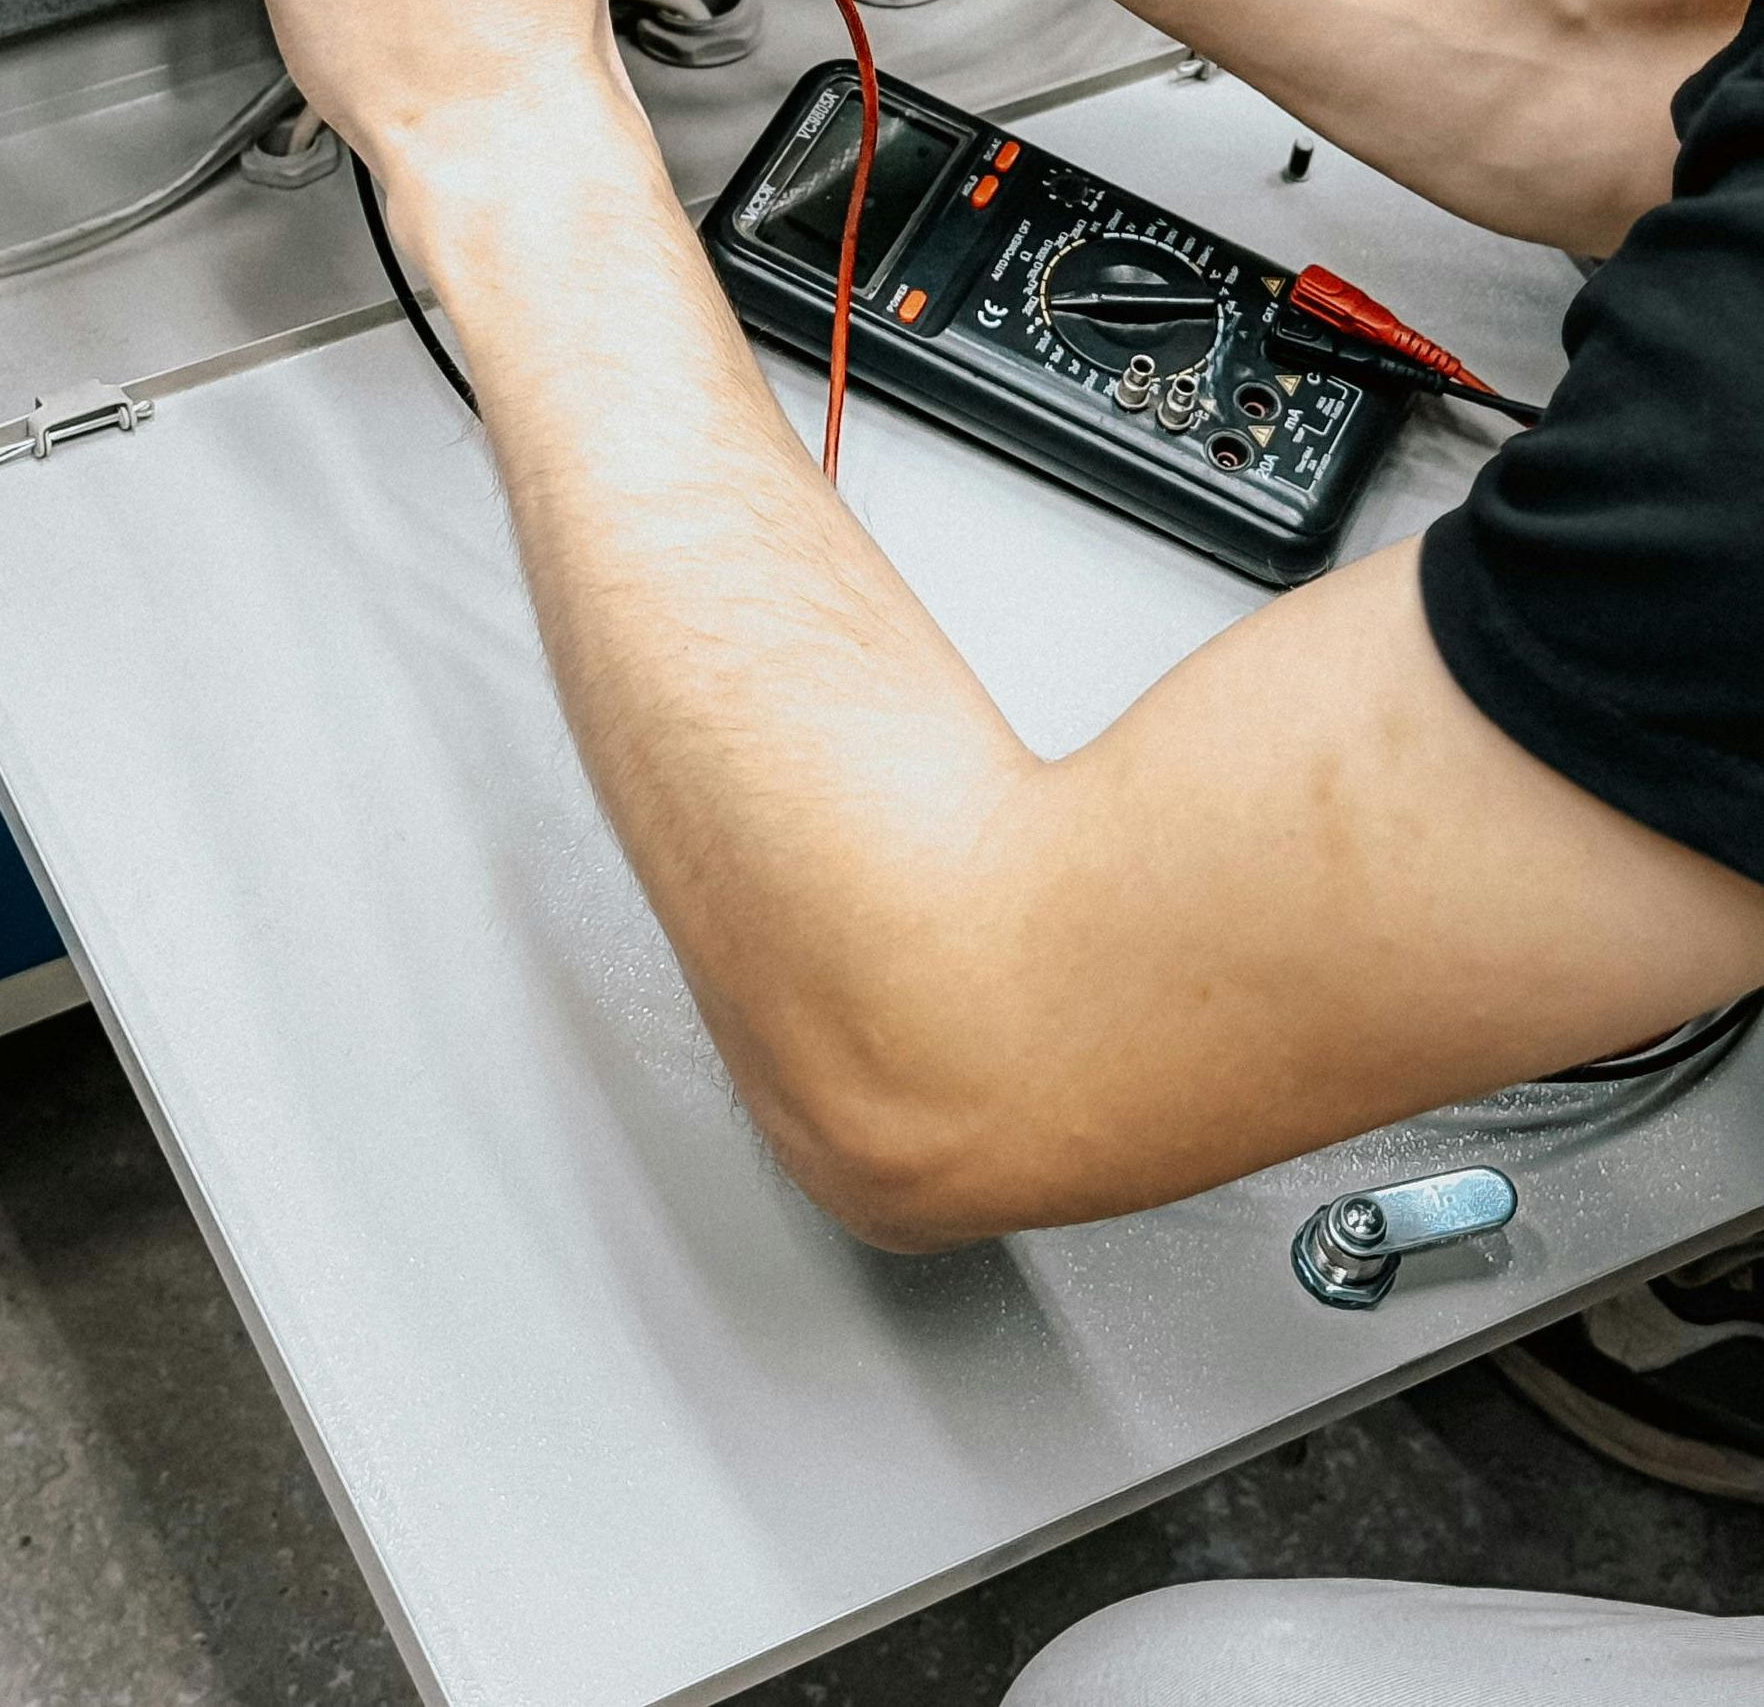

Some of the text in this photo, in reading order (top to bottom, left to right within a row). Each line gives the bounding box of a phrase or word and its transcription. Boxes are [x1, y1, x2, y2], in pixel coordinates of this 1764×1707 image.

[962, 175, 978, 196] HOLD
[991, 219, 1030, 280] AUTO POWER OFF
[886, 284, 908, 312] POWER
[1284, 409, 1302, 430] mA
[1255, 454, 1278, 481] 20A
